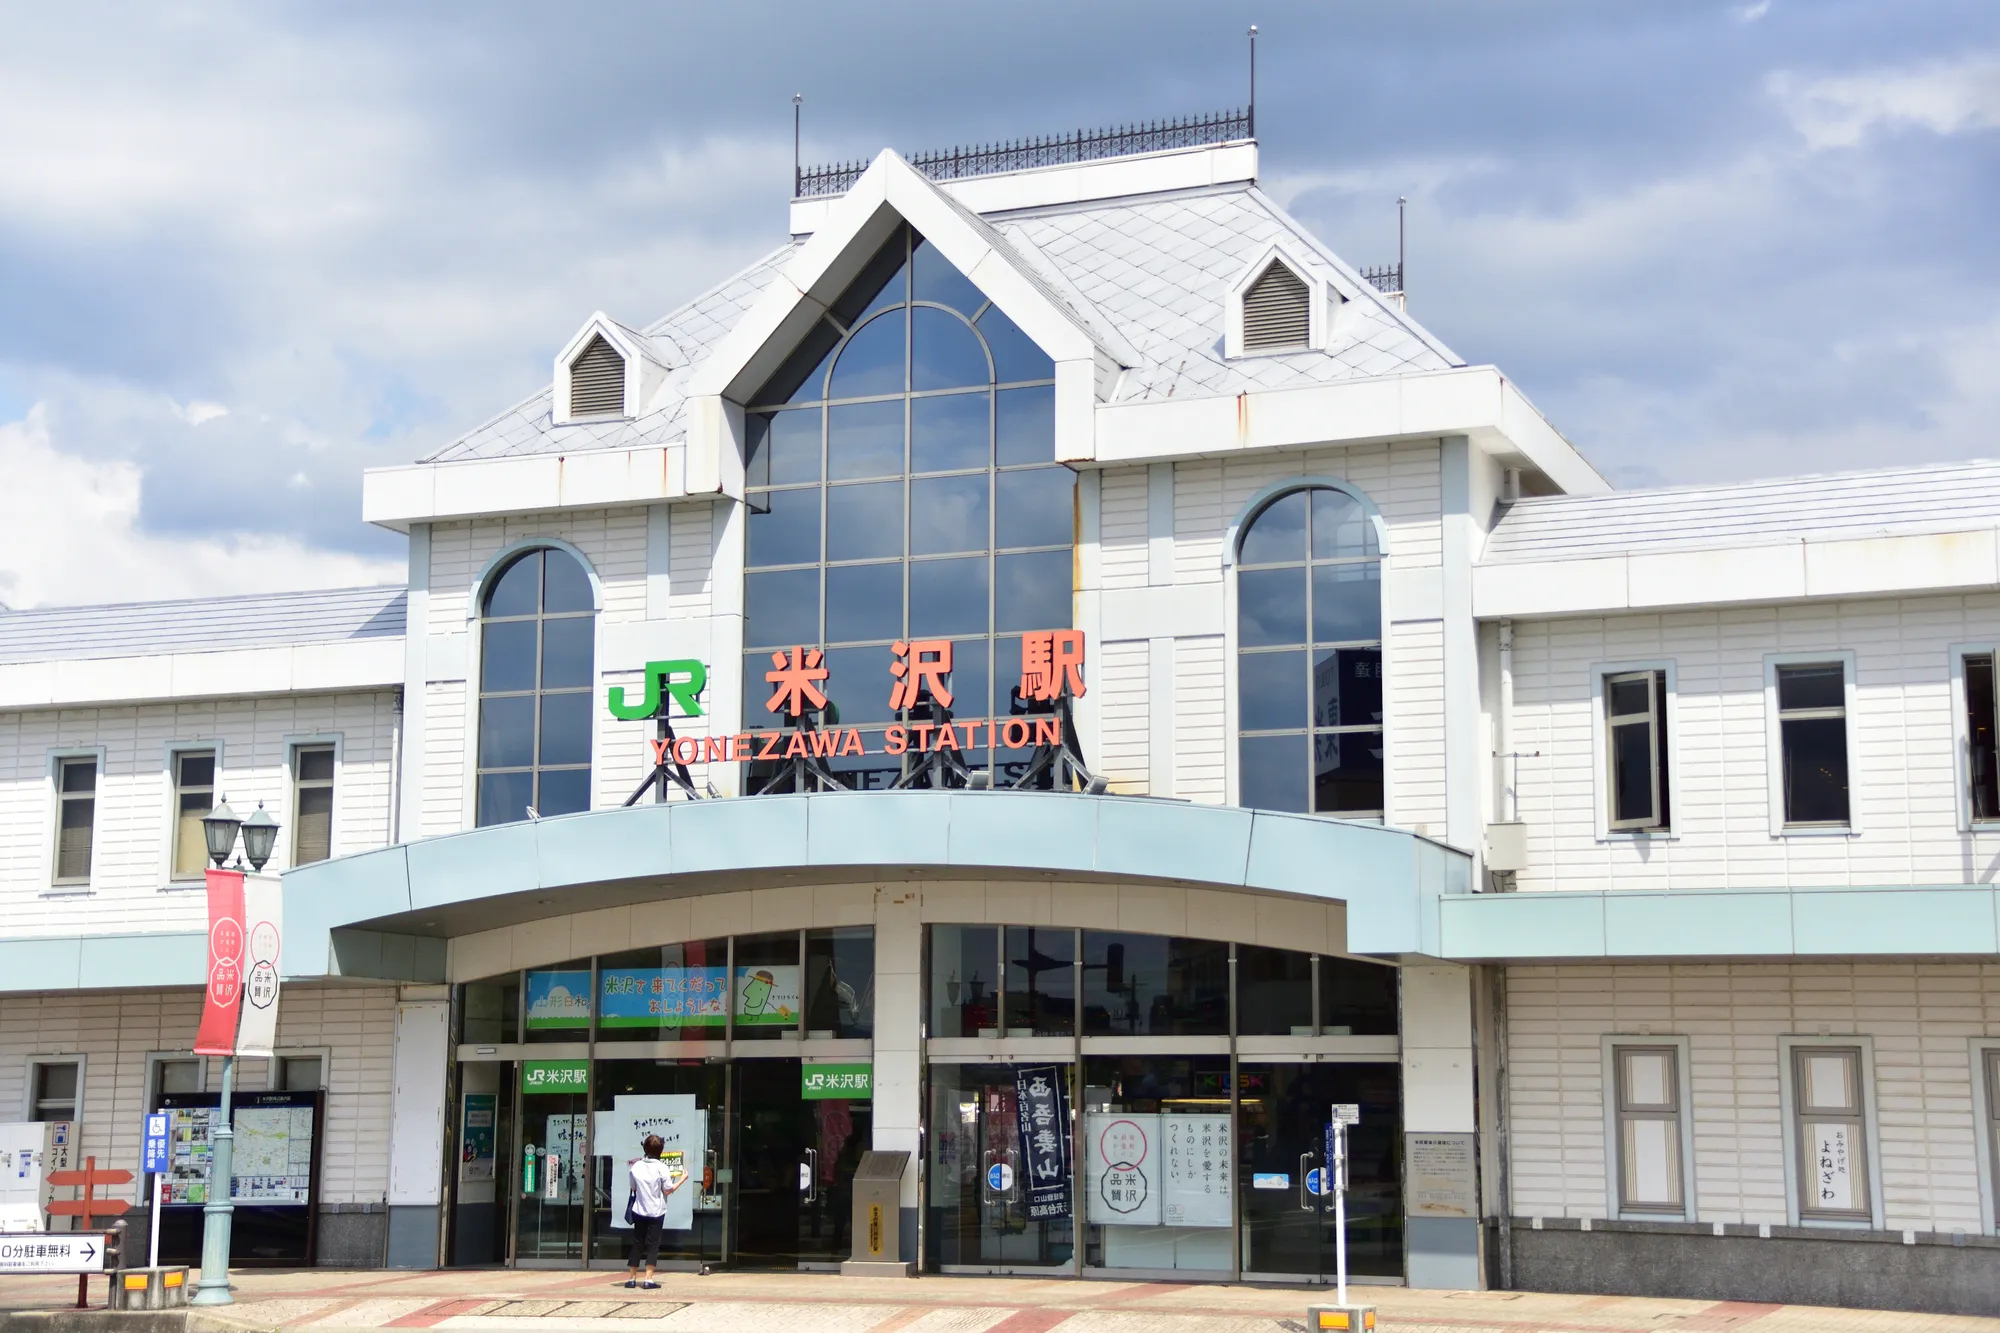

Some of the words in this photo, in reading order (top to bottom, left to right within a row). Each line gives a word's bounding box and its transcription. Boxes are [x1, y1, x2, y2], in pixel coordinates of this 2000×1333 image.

[608, 659, 707, 721] JR
[765, 629, 1087, 717] 米沢駅
[650, 727, 865, 766] YONEZAWA
[884, 717, 1061, 756] STATION
[527, 1069, 545, 1081] JR
[546, 1069, 587, 1084] 米沢駅
[805, 1073, 824, 1086] JR
[825, 1073, 868, 1089] 米沢駅
[60, 1146, 68, 1168] 大型
[147, 1138, 157, 1169] 乗降場
[157, 1138, 166, 1159] 優先
[1186, 1123, 1196, 1179] ものにしか
[1202, 1123, 1212, 1194] 米沢を愛する
[1836, 1131, 1847, 1174] おみやげ処
[1125, 1173, 1136, 1202] 米沢
[1820, 1140, 1835, 1200] よねざわ
